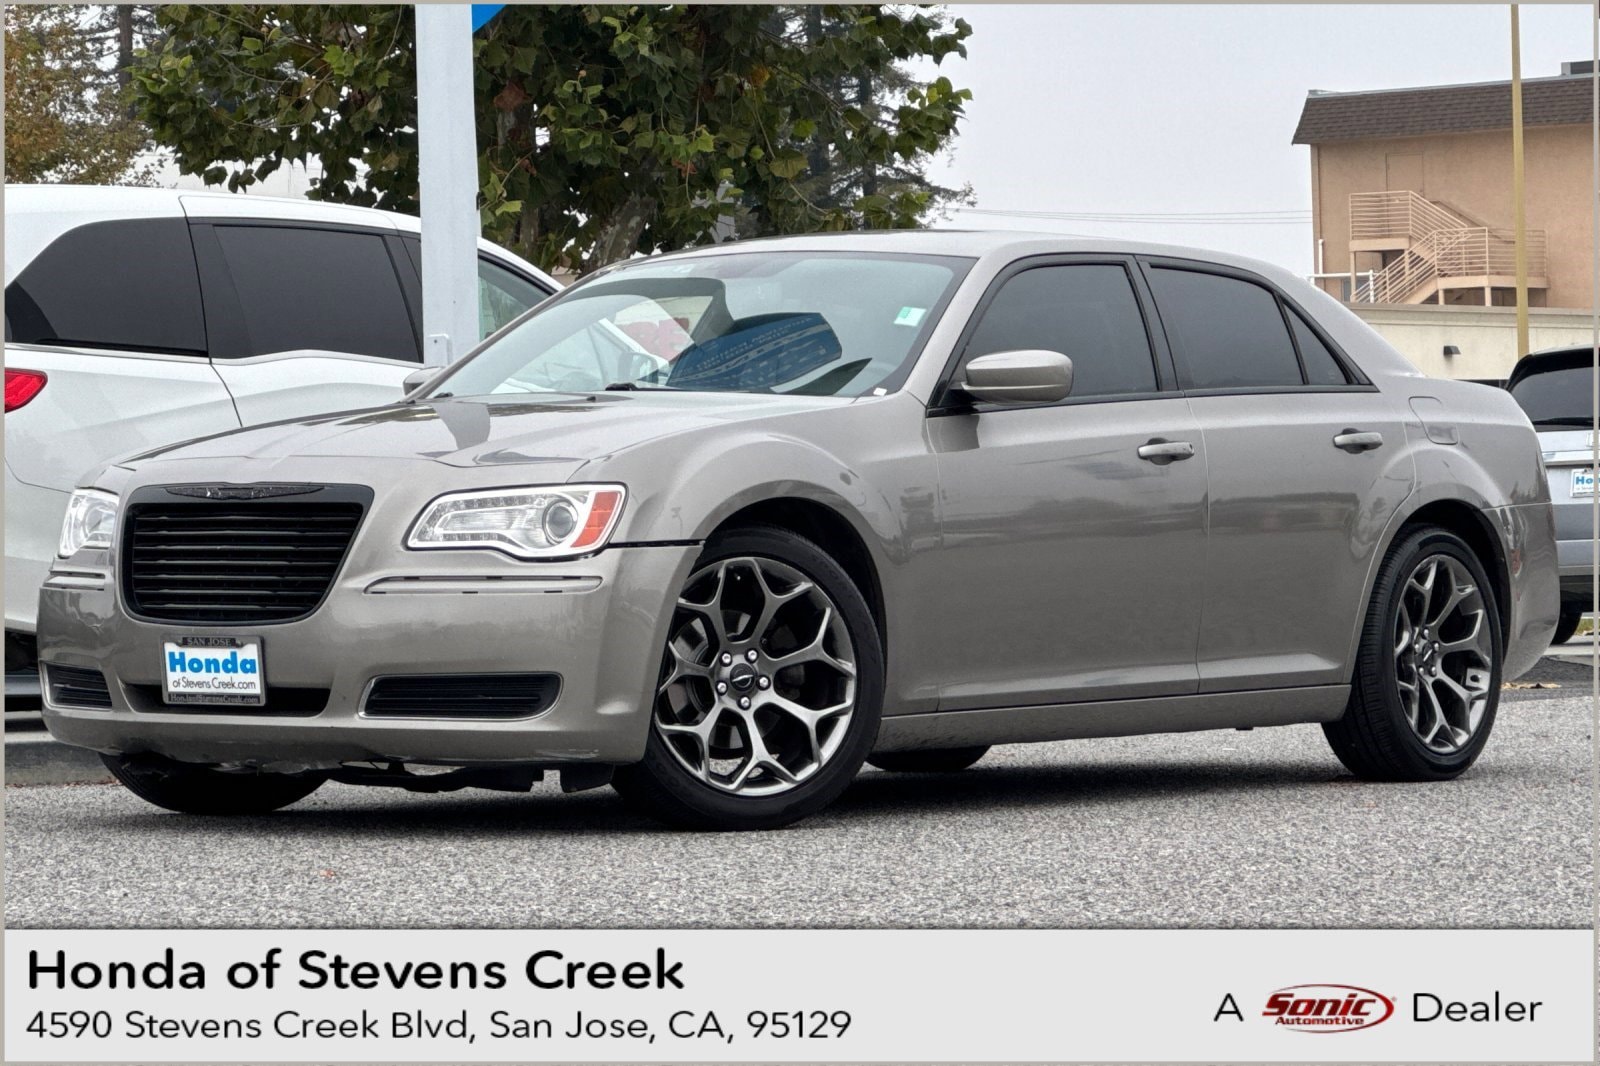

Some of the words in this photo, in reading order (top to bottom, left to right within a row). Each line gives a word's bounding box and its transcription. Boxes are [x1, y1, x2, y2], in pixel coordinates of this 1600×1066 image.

[187, 637, 206, 646] SAN
[208, 637, 231, 646] JOSE
[168, 651, 257, 674] Honda
[172, 677, 181, 688] of
[181, 676, 211, 689] Stevens
[211, 677, 256, 690] Creek.com
